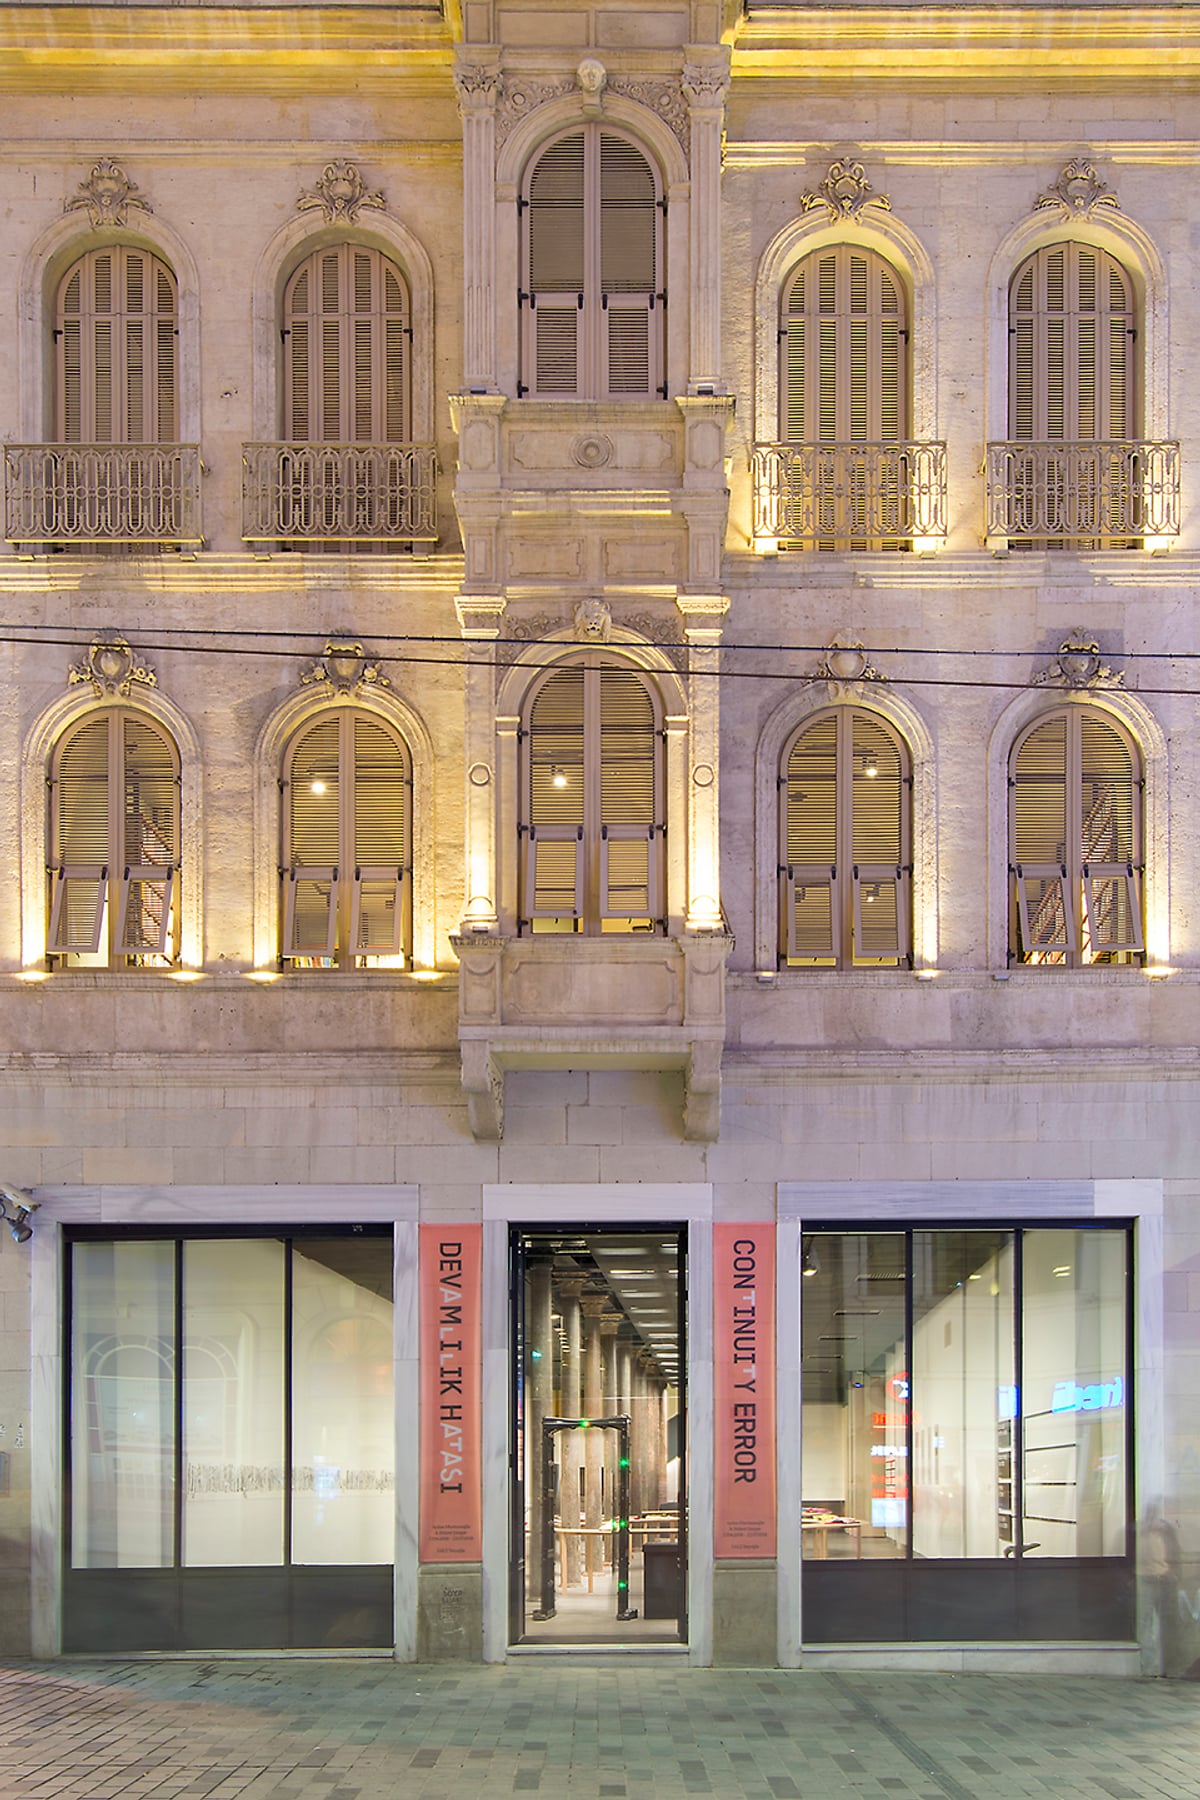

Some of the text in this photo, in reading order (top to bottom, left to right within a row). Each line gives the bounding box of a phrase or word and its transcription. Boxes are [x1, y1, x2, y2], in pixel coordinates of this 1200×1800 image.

[440, 1243, 463, 1494] DEVAMLILIK HATASI
[733, 1239, 757, 1483] CONTINUITY ERROR
